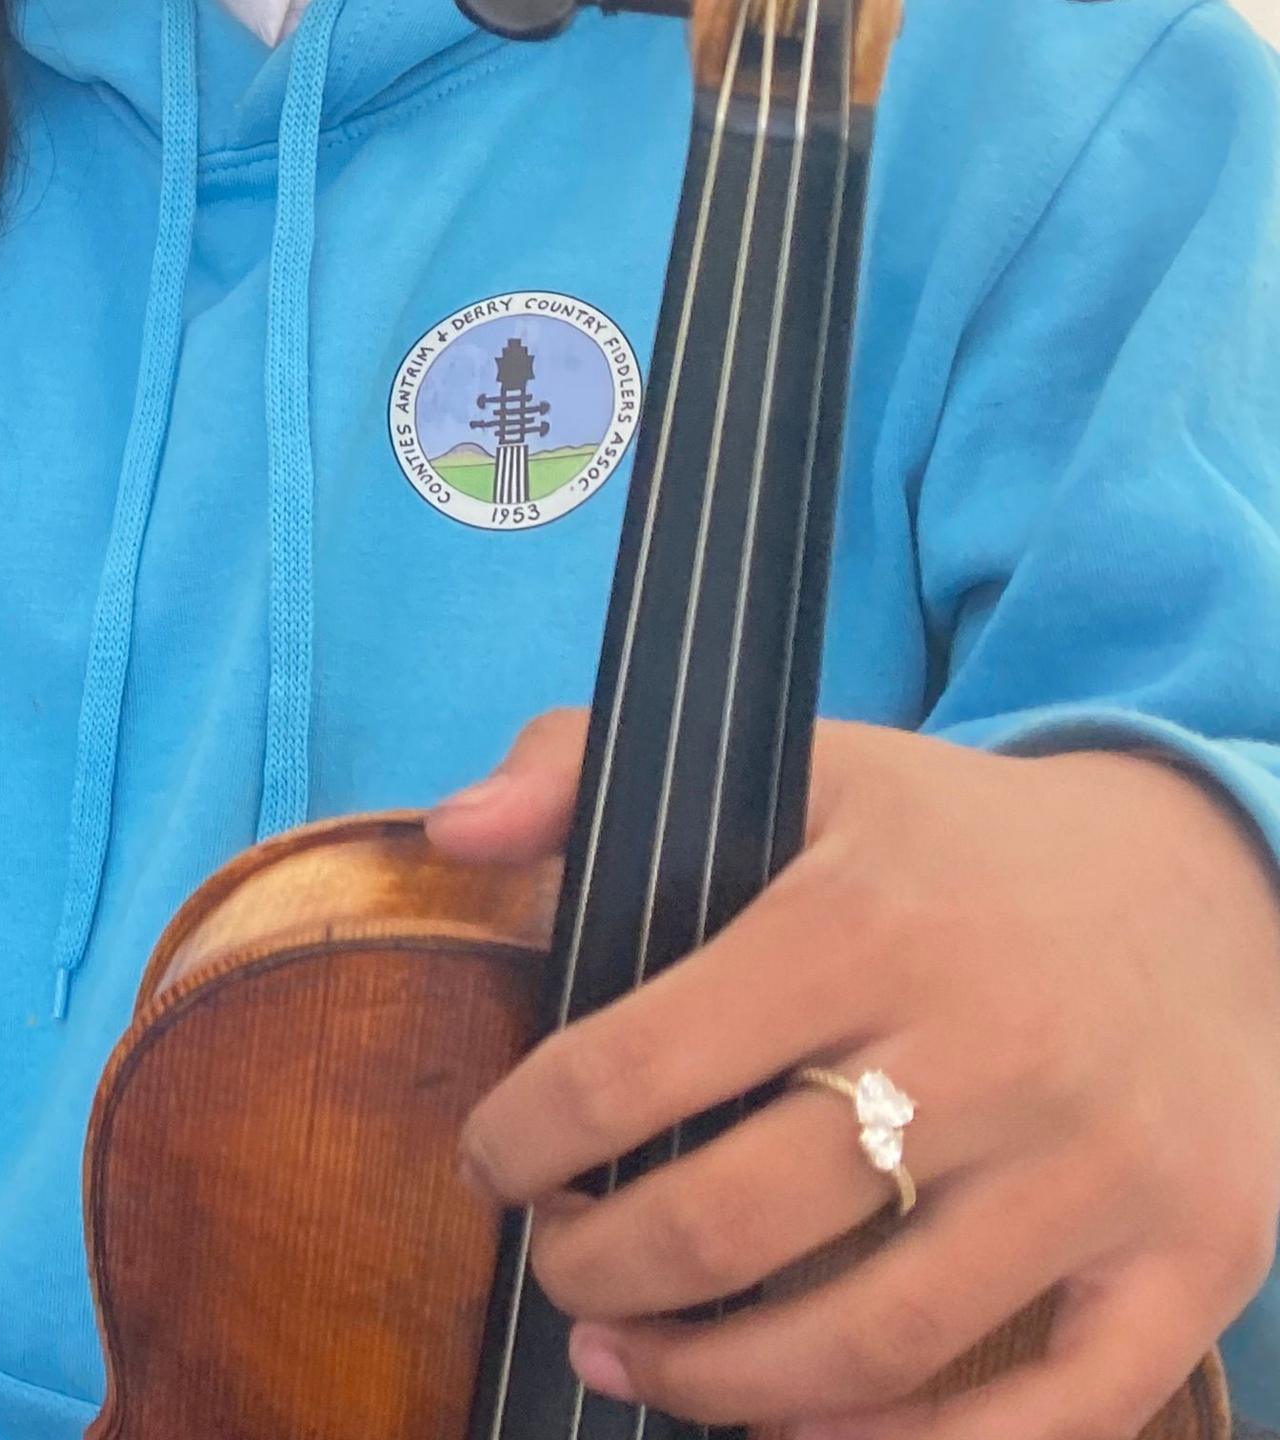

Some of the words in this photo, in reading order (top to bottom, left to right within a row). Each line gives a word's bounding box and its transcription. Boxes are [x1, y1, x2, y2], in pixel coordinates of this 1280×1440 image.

[451, 297, 513, 331] DERRY
[524, 297, 608, 335] COUNTRY
[395, 346, 435, 414] ANTRIM
[603, 336, 635, 424] FIDDLERS
[397, 423, 451, 503] COUNTIES
[570, 431, 624, 492] ASSOC.
[491, 503, 541, 524] 1953
